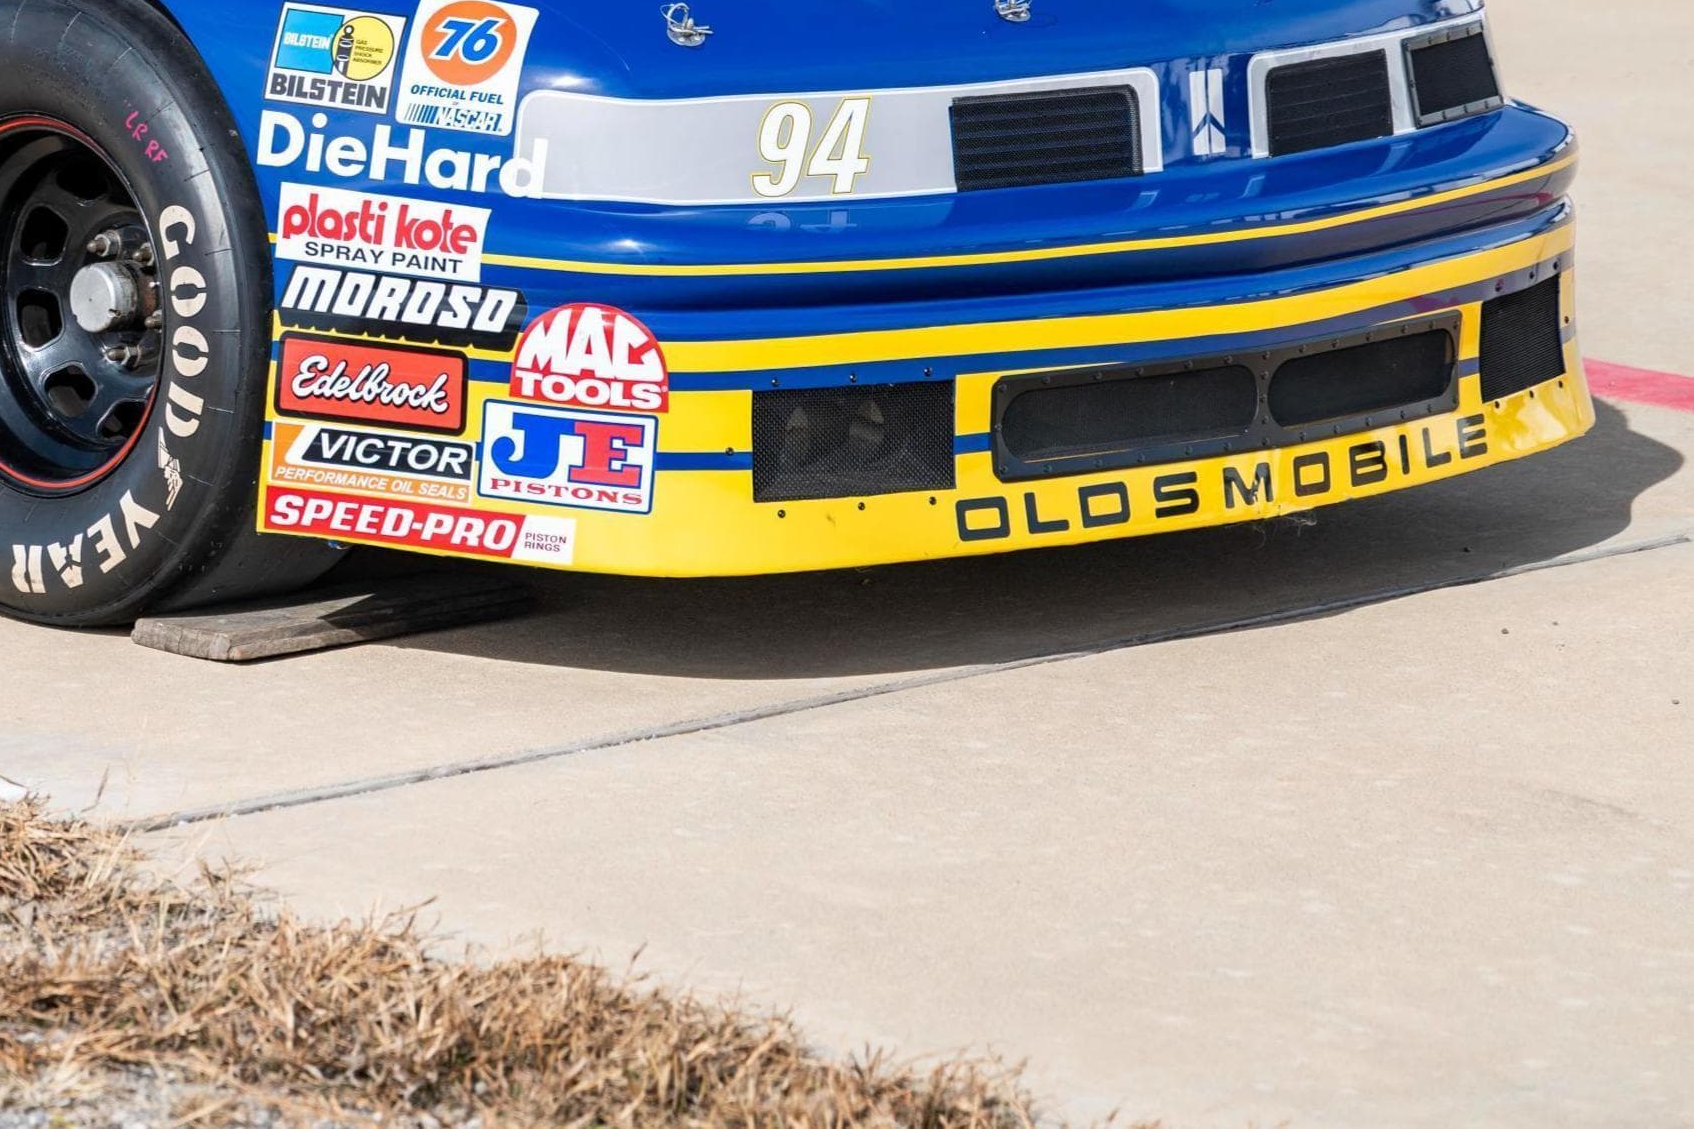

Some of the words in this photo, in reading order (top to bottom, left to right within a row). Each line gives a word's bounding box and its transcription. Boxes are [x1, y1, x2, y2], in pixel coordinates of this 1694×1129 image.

[282, 32, 331, 50] BILSTEIN
[429, 18, 507, 65] 76
[270, 72, 388, 110] BILSTEIN
[410, 84, 466, 100] OFFICIAL
[469, 91, 504, 105] FUEL
[437, 107, 502, 131] NASCAR
[256, 109, 549, 200] DieHard
[751, 95, 873, 198] 94
[282, 192, 389, 246] plasti
[393, 204, 478, 255] kote
[305, 242, 386, 265] SPRAY
[391, 252, 463, 275] PAINT
[281, 265, 518, 333] MOROSO
[515, 305, 665, 383] MAC
[290, 355, 450, 414] Edelbrock
[515, 370, 664, 411] TOOLS
[319, 431, 469, 475] VICTOR
[490, 411, 647, 490] JE
[275, 465, 388, 492] PERFORMANCE
[391, 479, 415, 493] OIL
[418, 483, 467, 501] SEALS
[489, 477, 643, 507] PISTONS
[956, 413, 1488, 542] OLDSMOBILE
[270, 494, 517, 552] SPEED-PRO
[525, 531, 567, 545] PISTON
[524, 540, 561, 553] RINGS
